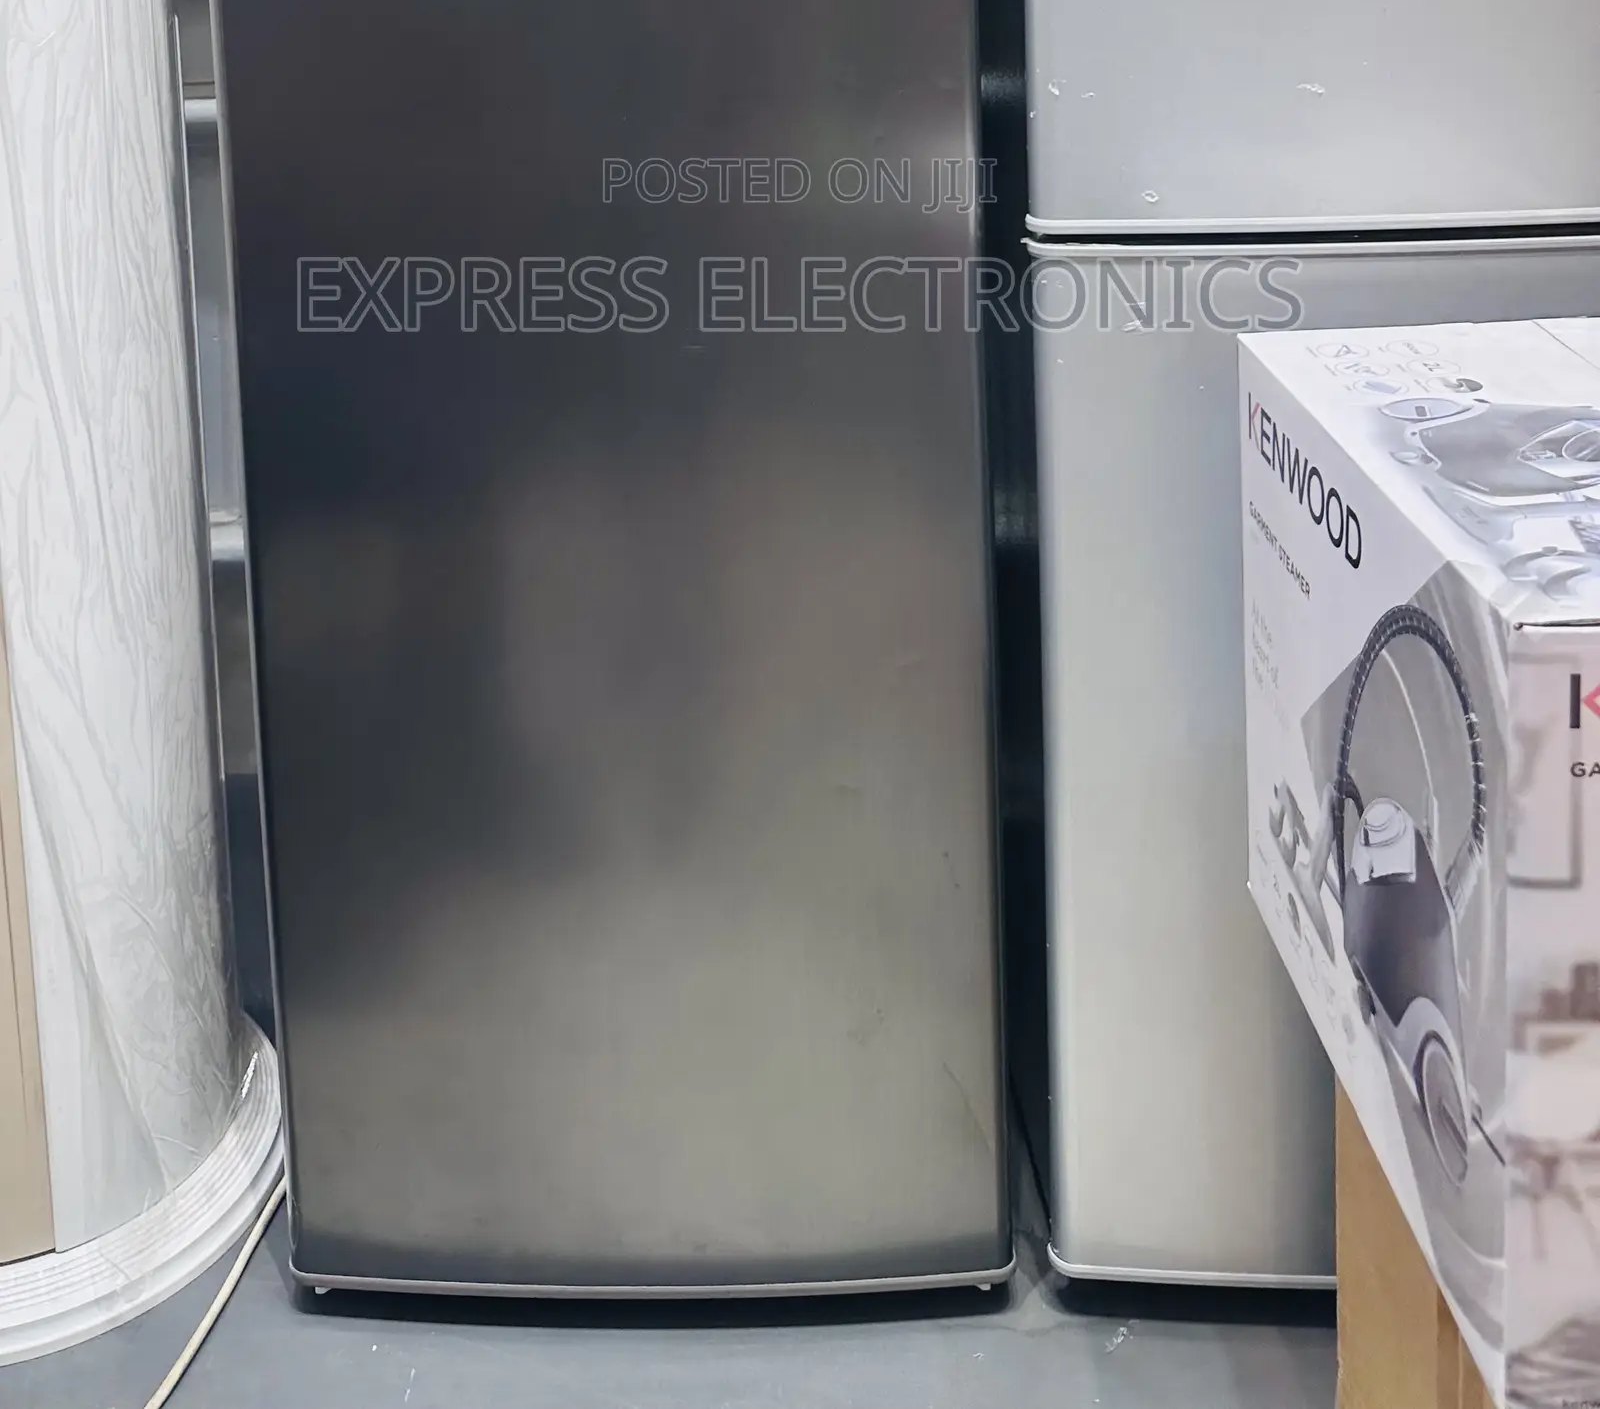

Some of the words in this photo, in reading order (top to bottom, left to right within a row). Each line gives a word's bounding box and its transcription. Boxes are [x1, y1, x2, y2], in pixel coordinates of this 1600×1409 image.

[1248, 392, 1362, 569] KENWOOD
[1249, 501, 1278, 551] GARMENT
[1279, 544, 1310, 601] STEAMER
